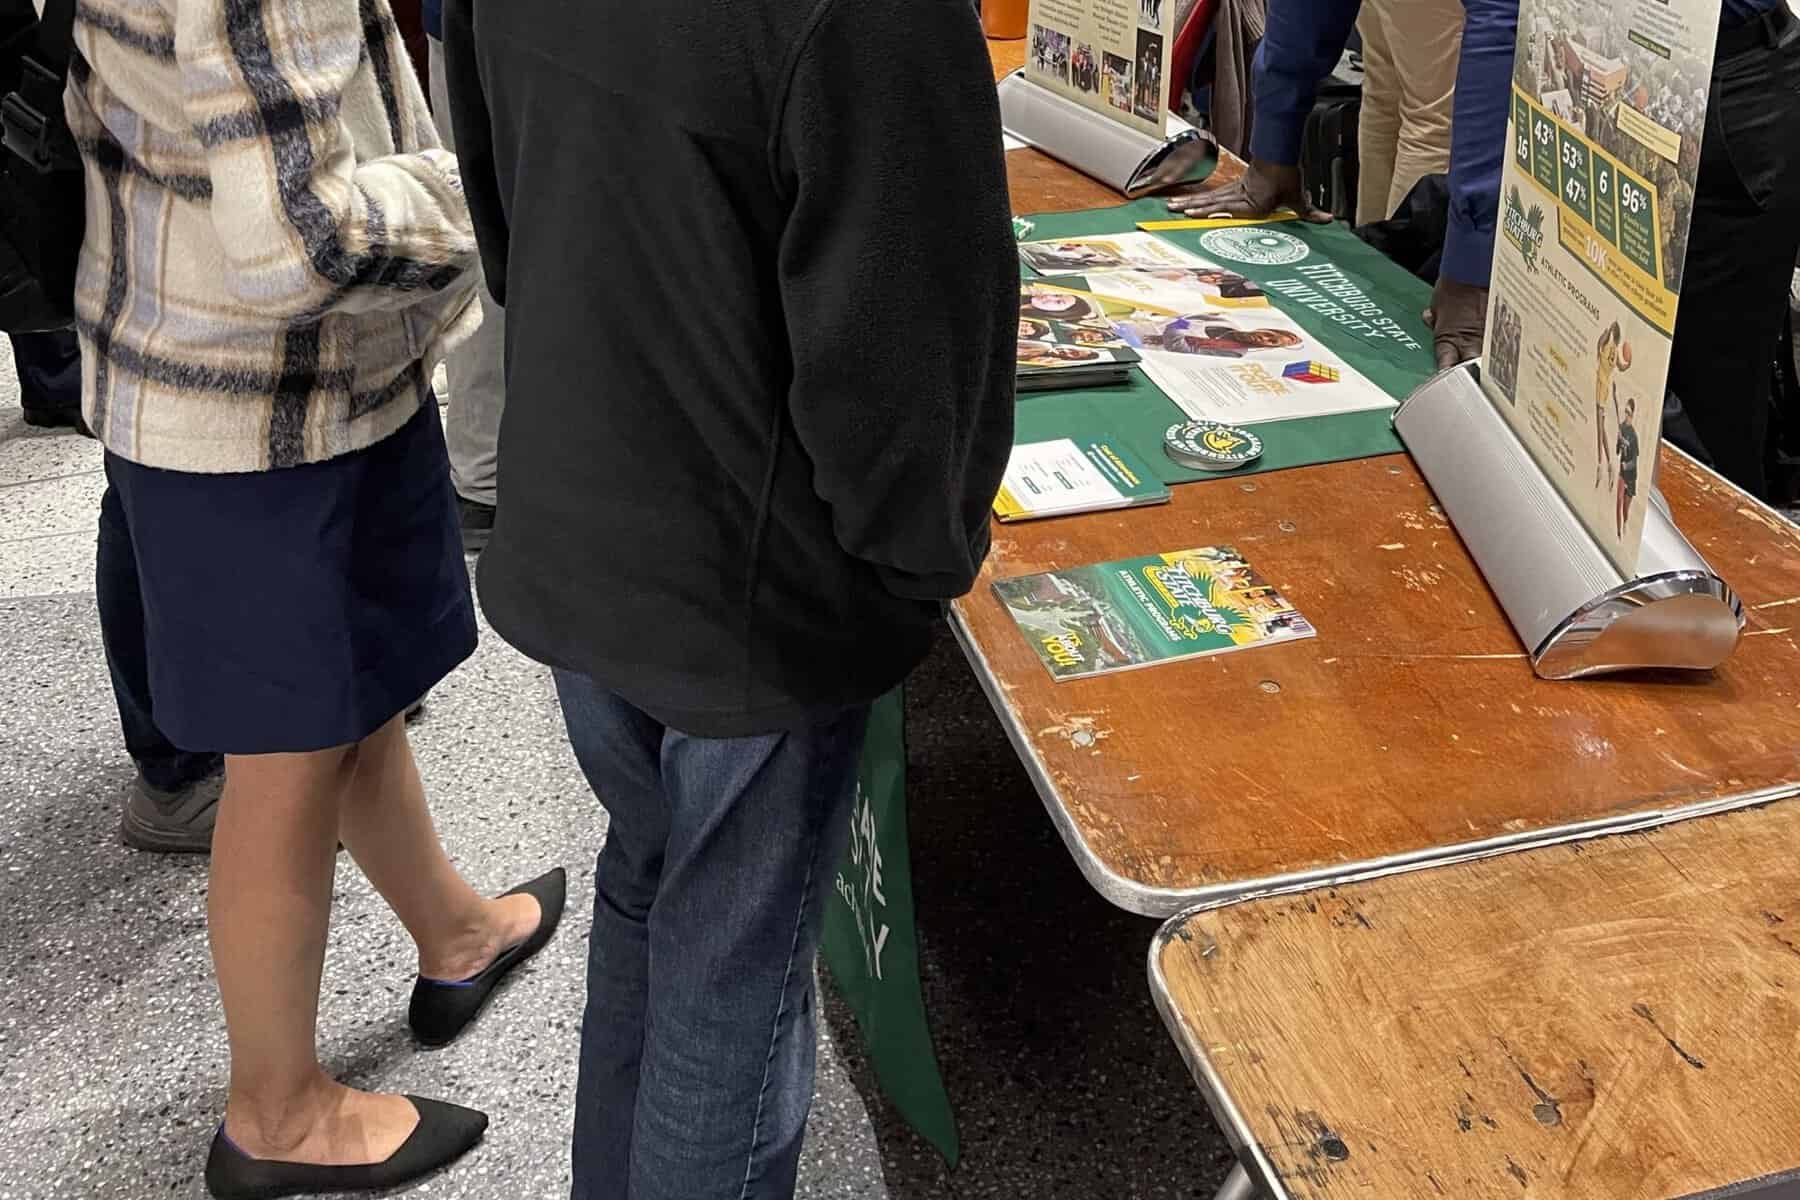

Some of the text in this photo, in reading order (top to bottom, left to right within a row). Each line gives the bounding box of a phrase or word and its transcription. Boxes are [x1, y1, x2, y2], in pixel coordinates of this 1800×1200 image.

[1517, 135, 1529, 160] 16
[1534, 119, 1555, 146] 43%
[1562, 141, 1583, 169] 53%
[1565, 177, 1587, 203] 47%
[1599, 170, 1609, 195] 6
[1621, 182, 1648, 214] 96%
[1541, 256, 1568, 289] ATHLETIC
[1567, 281, 1600, 321] PROGRAMS
[1265, 278, 1387, 339] UNIVERSITY
[1295, 262, 1422, 351] FITCHBURG STATE
[1155, 568, 1197, 608] STATE
[1167, 559, 1233, 635] FITCHBURG
[1118, 569, 1182, 642] ATHLETIC PROGRAMS
[1041, 636, 1078, 667] YOU!
